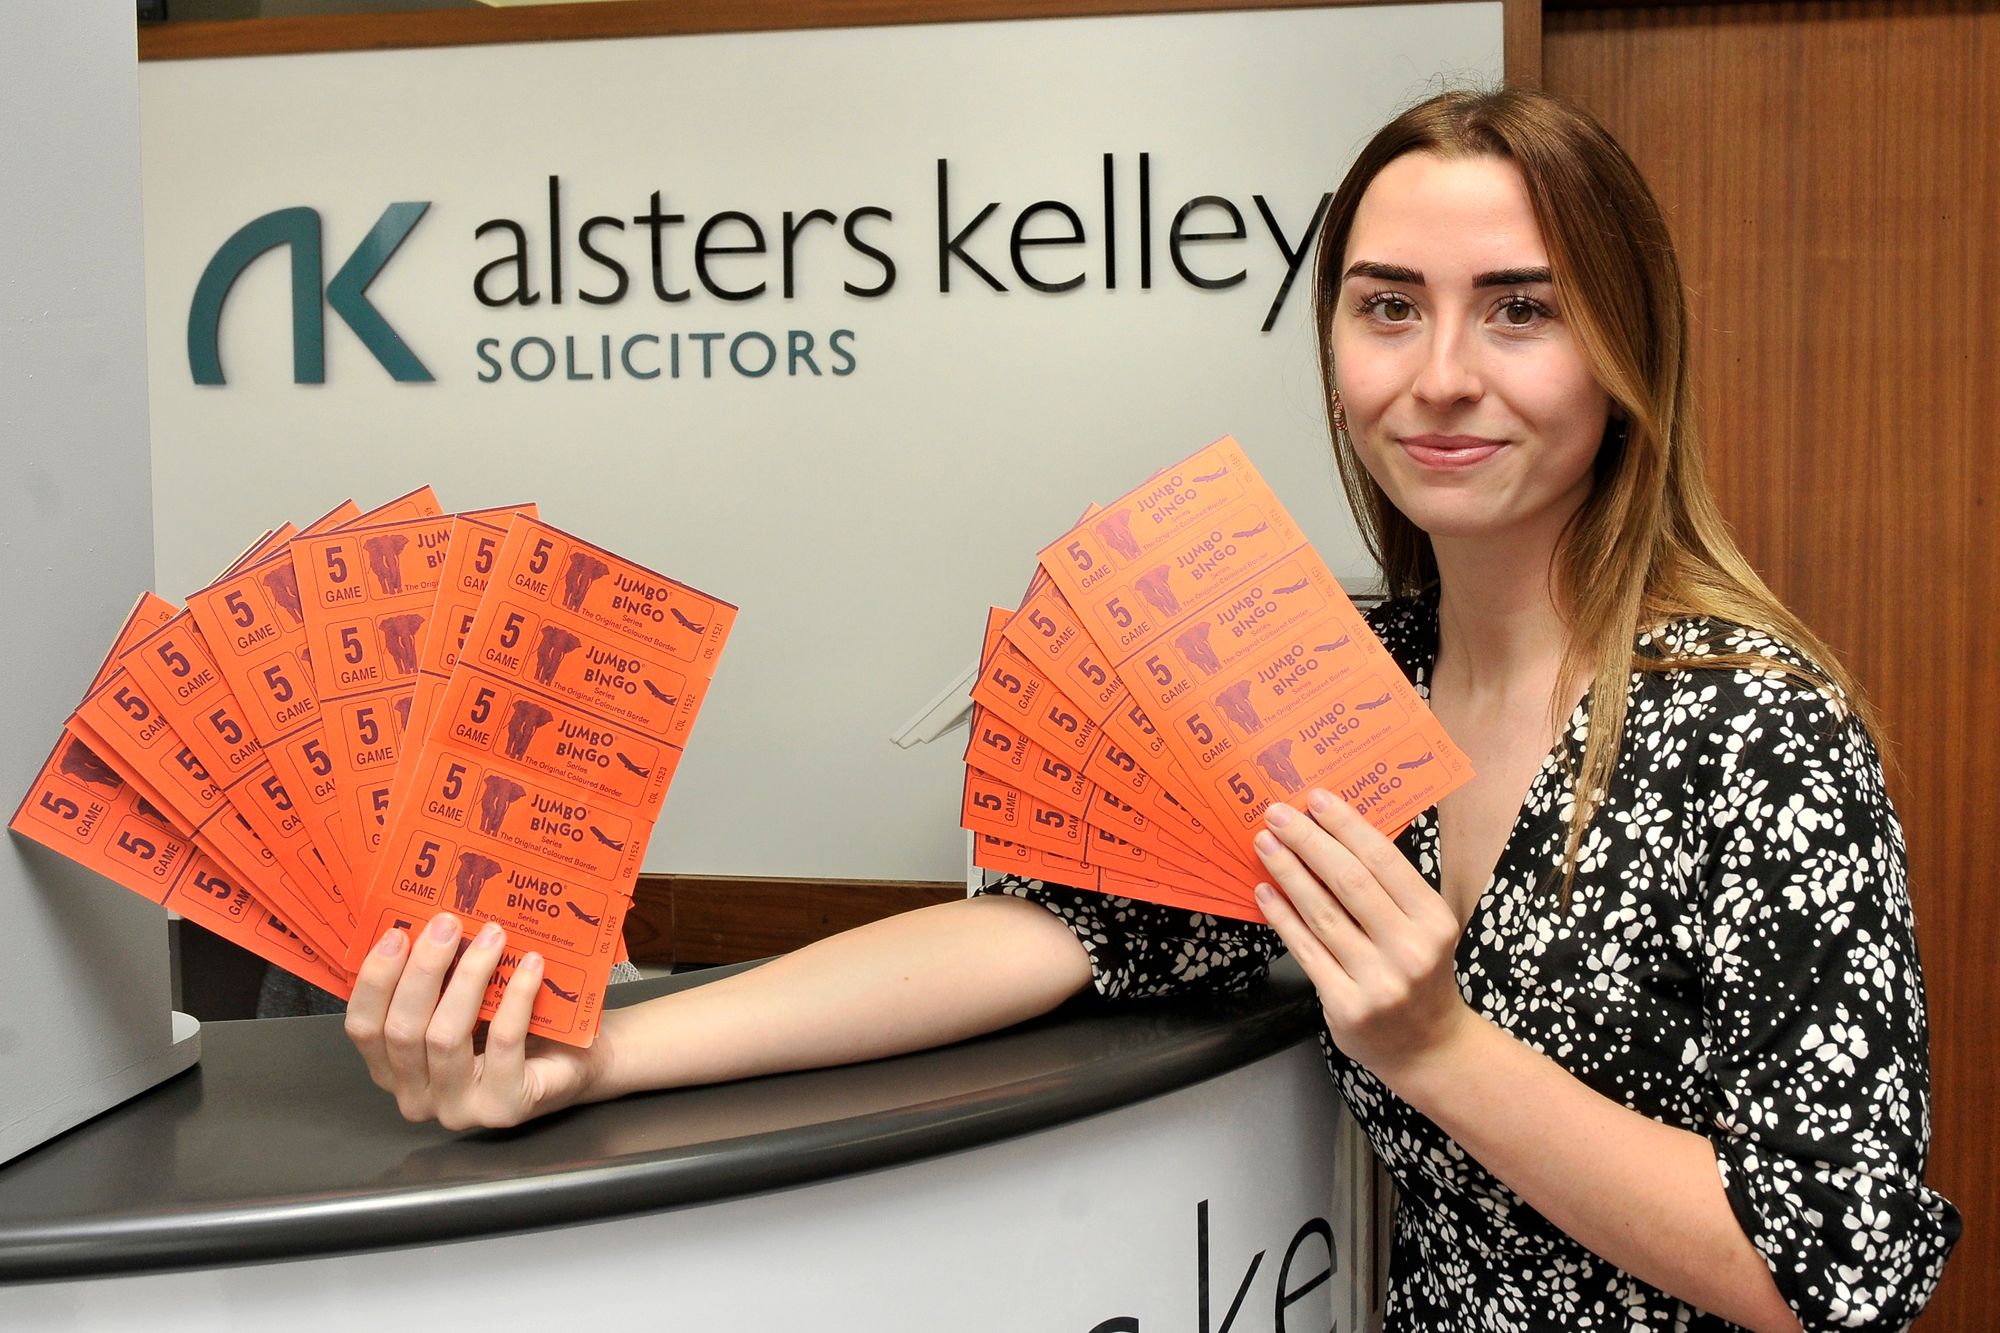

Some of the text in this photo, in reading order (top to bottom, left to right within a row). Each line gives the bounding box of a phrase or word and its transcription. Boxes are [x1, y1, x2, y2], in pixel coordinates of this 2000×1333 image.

[472, 152, 1333, 332] alsters kelley
[477, 329, 856, 383] SOLICITORS
[1138, 476, 1183, 512] JUMBO
[1152, 489, 1196, 524] BINGO
[326, 546, 347, 583] 5
[475, 538, 495, 573] 5
[530, 538, 553, 574] 5
[1067, 541, 1092, 570] 5
[1177, 532, 1222, 568] JUMBO
[1192, 545, 1236, 580] BINGO
[405, 583, 419, 591] The
[464, 576, 488, 590] GAM
[516, 574, 548, 595] GAME
[614, 574, 668, 602] JUMBO
[1082, 564, 1111, 588] GAME
[326, 586, 362, 602] GAME
[1217, 588, 1262, 625] JUMBO
[224, 590, 254, 628] 5
[612, 596, 664, 622] BINGO
[622, 615, 642, 628] Series
[1028, 609, 1056, 637] 5
[1106, 598, 1132, 628] 5
[1232, 602, 1277, 638] BINGO
[238, 624, 275, 648] GAME
[500, 612, 524, 648] 5
[582, 608, 676, 652] The Original Coloured Border
[1050, 627, 1075, 653] GAME
[1121, 622, 1150, 645] GAME
[157, 641, 190, 677] 5
[341, 627, 363, 664] 5
[486, 649, 519, 670] GAME
[586, 646, 640, 673] JUMBO
[703, 645, 714, 660] COL
[341, 667, 377, 683] GAME
[1078, 657, 1106, 685] 5
[1146, 655, 1172, 686] 5
[1258, 645, 1303, 683] JUMBO
[1273, 659, 1318, 696] BINGO
[178, 669, 214, 698] GAME
[264, 665, 293, 702] 5
[584, 669, 636, 694] BINGO
[594, 687, 615, 700] Series
[992, 668, 1021, 693] 5
[1019, 680, 1040, 709] GAME
[1161, 680, 1190, 704] GAME
[1263, 664, 1351, 724] The Original Coloured Border
[113, 686, 149, 721] 5
[276, 698, 314, 723] GAME
[471, 688, 496, 723] 5
[554, 682, 650, 724] The Original Coloured Border
[140, 715, 168, 741] GAM
[209, 708, 242, 744] 5
[357, 708, 378, 745] 5
[558, 720, 613, 746] JUMBO
[674, 717, 686, 732] COL
[1048, 706, 1077, 732] 5
[1075, 719, 1097, 748] GAME
[1128, 706, 1156, 734] 5
[1186, 714, 1213, 744] 5
[1299, 703, 1345, 742] JUMBO
[456, 724, 490, 745] GAME
[983, 729, 1011, 752] 5
[1314, 718, 1359, 755] BINGO
[175, 746, 210, 780] 5
[302, 739, 332, 776] 5
[357, 747, 393, 764] GAME
[556, 742, 610, 768] BINGO
[1012, 735, 1028, 765] GAME
[1105, 746, 1136, 772] 5
[1202, 738, 1231, 763] GAME
[1304, 723, 1393, 783] The Original Coloured Border
[443, 763, 466, 800] 5
[526, 756, 622, 797] The Original Coloured Border
[567, 761, 587, 774] Series
[1043, 758, 1071, 782] 5
[1341, 762, 1387, 802] JUMBO
[261, 776, 293, 810] 5
[647, 765, 667, 805] COL 11523
[1228, 773, 1254, 804] 5
[1356, 777, 1402, 815] BINGO
[40, 791, 79, 820] 5
[429, 801, 463, 821] GAME
[531, 794, 586, 820] JUMBO
[974, 792, 1001, 810] 5
[1005, 791, 1016, 821] GAME
[1244, 798, 1270, 822] GAME
[1383, 782, 1434, 819] Coloured Border
[76, 802, 103, 836] GAME
[530, 817, 583, 842] BINGO
[1036, 808, 1064, 828] 5
[117, 831, 156, 860] 5
[501, 832, 597, 871] The Original Coloured Border
[541, 836, 562, 848] Series
[153, 842, 180, 876] GAME
[415, 841, 440, 878] 5
[622, 864, 634, 879] COL
[193, 871, 232, 899] 5
[400, 879, 436, 900] GAME
[507, 870, 562, 896] JUMBO
[229, 887, 251, 915] GAM
[507, 894, 560, 918] BINGO
[476, 909, 574, 946] The Original Coloured Border
[518, 912, 538, 925] Series
[599, 914, 618, 954] COL 11525
[578, 991, 597, 1032] COL 11526
